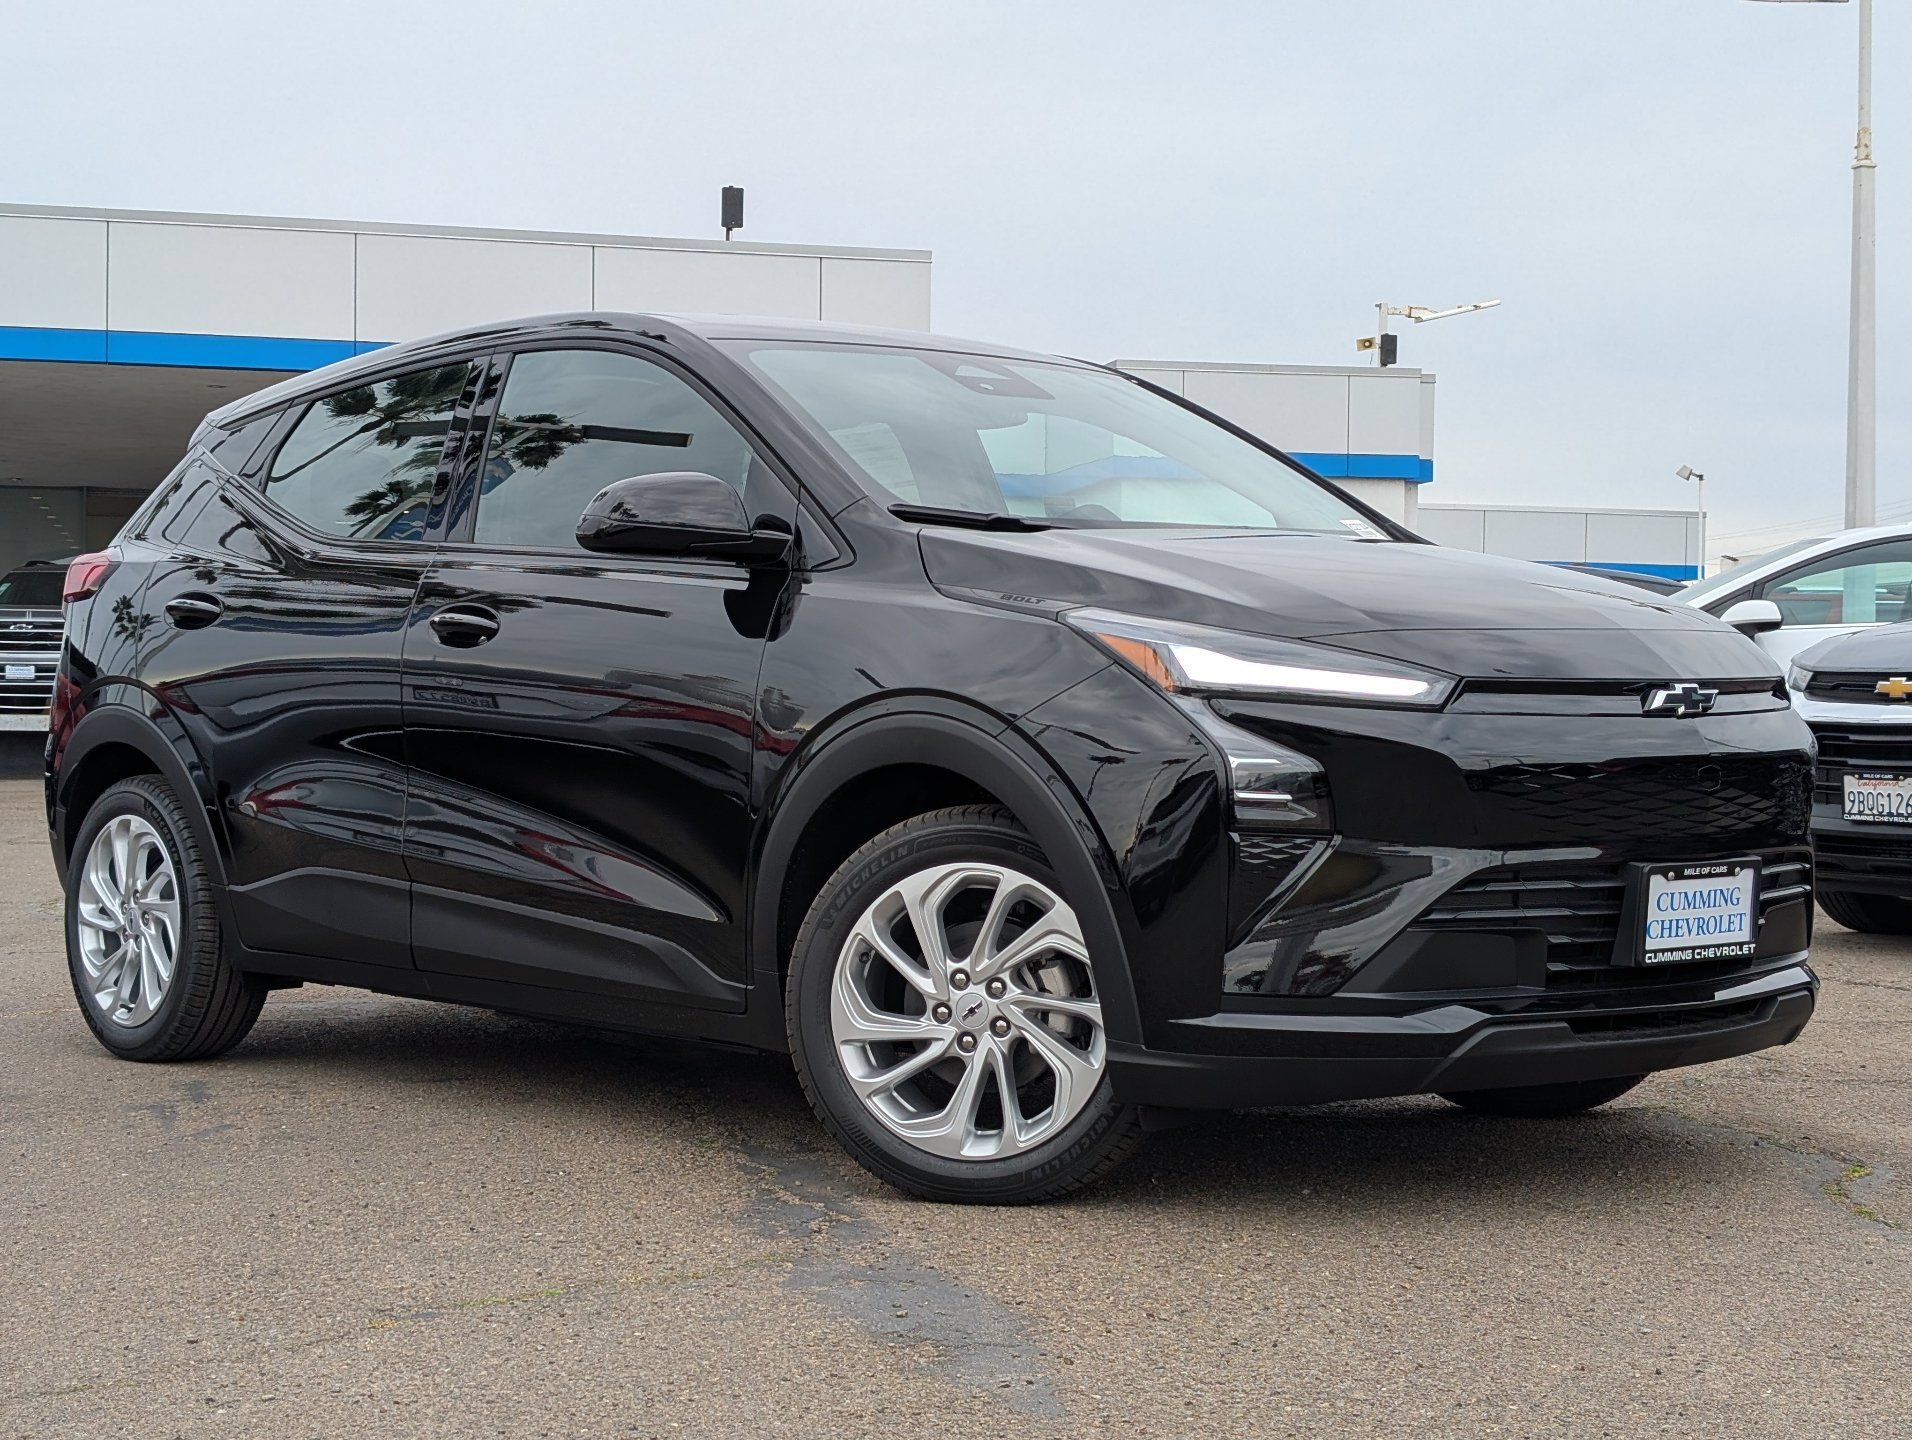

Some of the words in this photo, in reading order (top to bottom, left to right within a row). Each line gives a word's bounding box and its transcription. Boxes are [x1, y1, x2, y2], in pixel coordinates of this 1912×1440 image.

[1000, 593, 1046, 605] BOLT
[1857, 779, 1901, 790] California
[1848, 791, 1912, 815] 9BQG126
[836, 846, 909, 909] MICHELIN
[1684, 867, 1700, 876] MILE
[1701, 866, 1710, 875] OF
[1711, 866, 1728, 874] CARS
[1656, 887, 1741, 912] CUMMING
[1647, 913, 1746, 940] CHEVROLET
[1645, 950, 1692, 963] CUMMING
[1694, 944, 1756, 959] CHEVROLET
